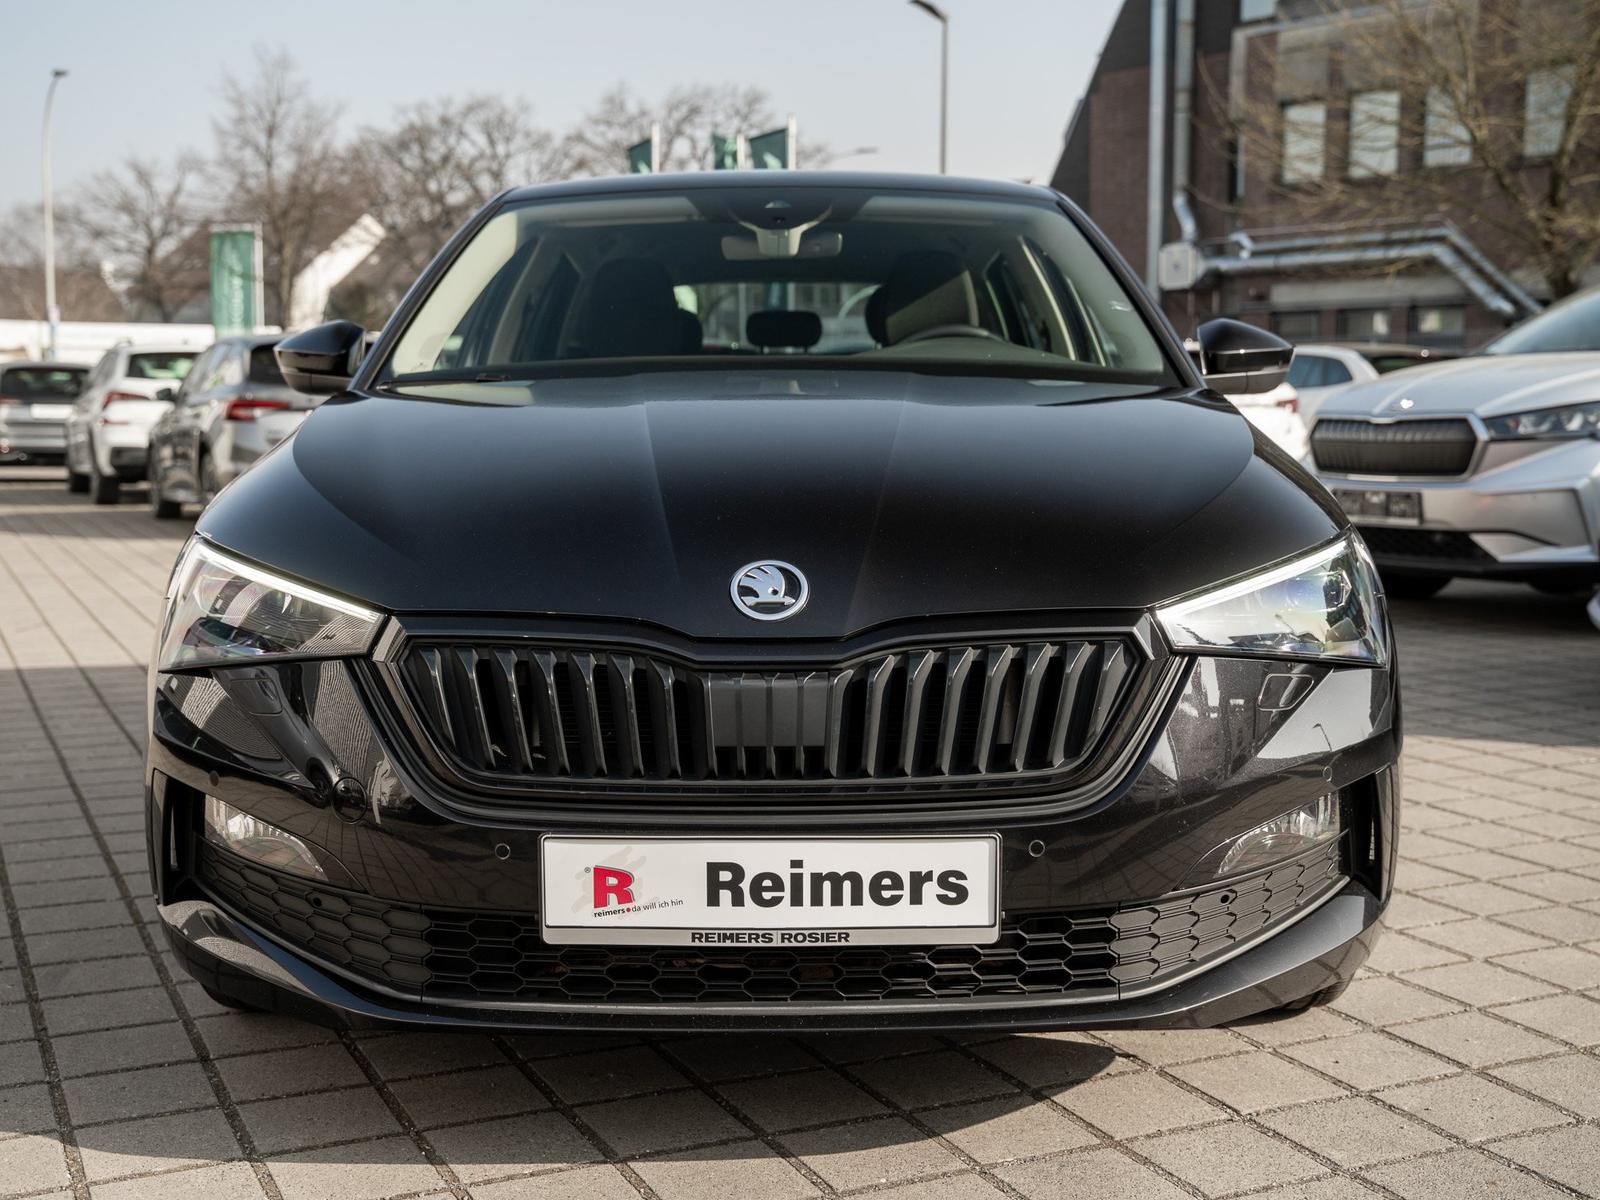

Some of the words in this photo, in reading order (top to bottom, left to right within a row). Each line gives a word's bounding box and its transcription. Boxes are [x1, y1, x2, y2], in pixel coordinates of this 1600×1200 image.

[593, 865, 635, 909] R
[706, 860, 970, 908] Reimers
[642, 902, 657, 911] will
[658, 899, 670, 909] ich
[670, 898, 684, 907] hin
[691, 932, 774, 944] REIMERS
[780, 932, 851, 944] ROSIER
